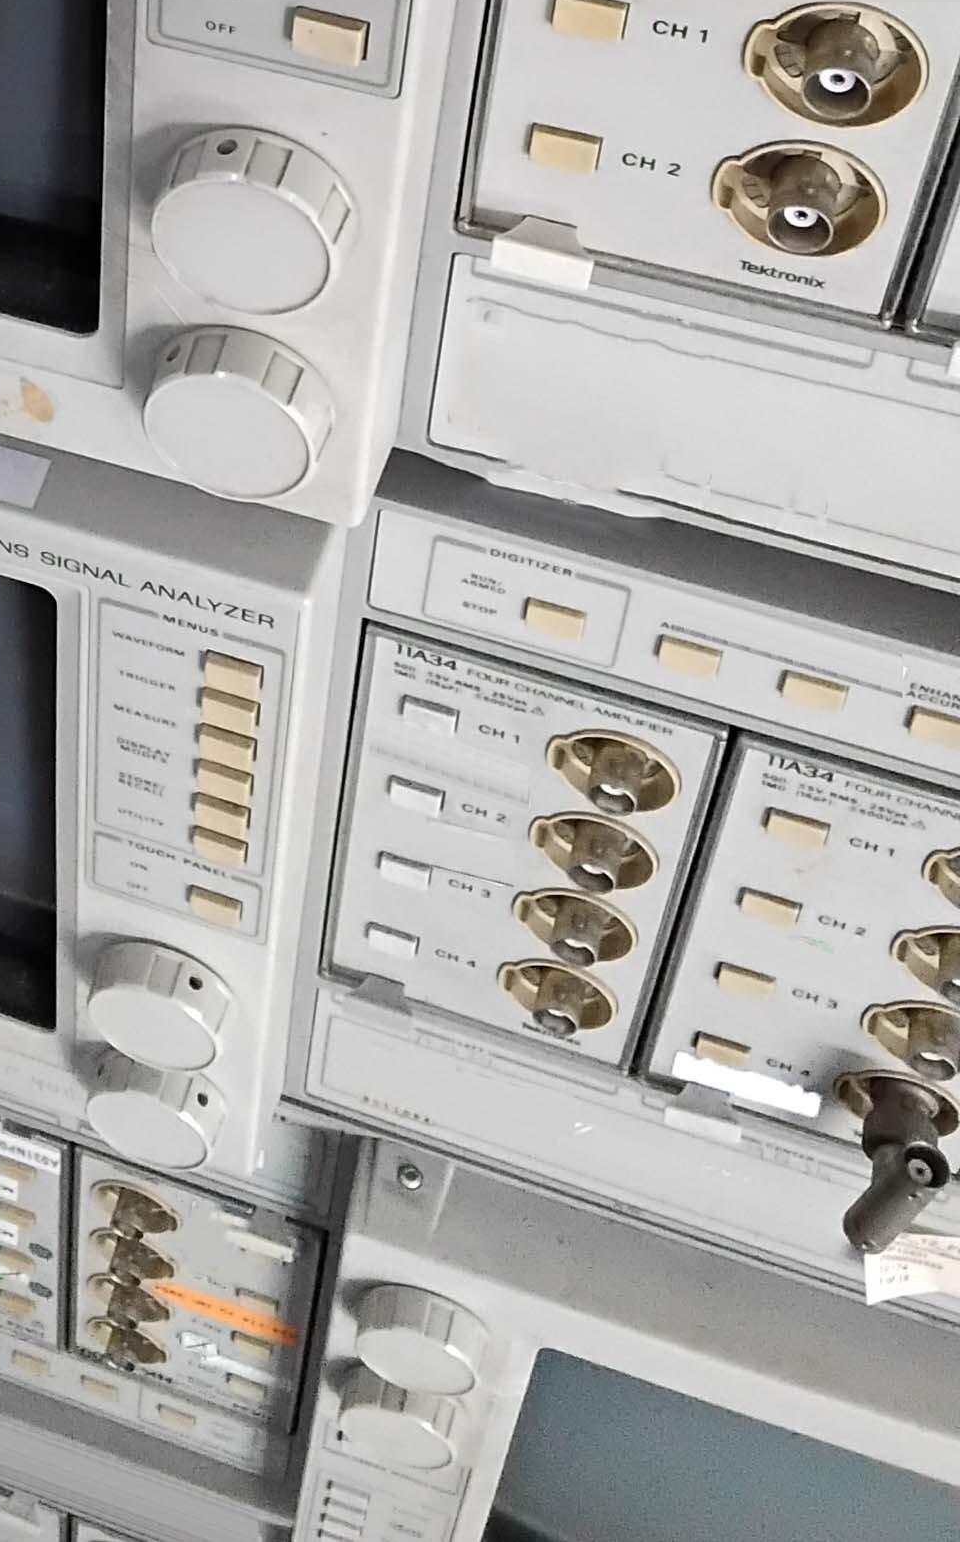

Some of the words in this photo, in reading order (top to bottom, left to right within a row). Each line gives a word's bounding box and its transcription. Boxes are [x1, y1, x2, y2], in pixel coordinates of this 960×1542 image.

[205, 20, 238, 35] OFF
[652, 19, 688, 41] CH
[698, 28, 710, 44] 1
[621, 151, 656, 172] CH
[667, 161, 682, 177] 2
[738, 259, 827, 290] Tektronix
[490, 547, 573, 577] DIGITIZER
[40, 550, 130, 588] SIGNAL
[140, 580, 276, 630] ANALYZER
[462, 601, 497, 615] STOP
[162, 614, 219, 637] MENUS
[111, 629, 185, 657] WAVEFORM
[395, 642, 457, 671] 11A34
[466, 667, 510, 689] FOUR
[514, 682, 587, 710] CHANNEL
[594, 706, 674, 737] AMPLIFIER
[479, 723, 506, 740] CH
[512, 734, 521, 744] 1
[767, 754, 834, 783] 11A34
[844, 779, 892, 802] FOUR
[461, 801, 490, 817] CH
[496, 811, 508, 824] 2
[849, 837, 878, 853] CH
[888, 847, 896, 858] 1
[448, 877, 477, 892] CH
[481, 889, 492, 899] 3
[818, 915, 848, 931] CH
[853, 924, 867, 937] 2
[434, 947, 462, 962] CH
[465, 957, 477, 968] 4
[792, 987, 822, 1004] CH
[826, 998, 839, 1010] 3
[766, 1058, 793, 1073] CH
[798, 1066, 812, 1078] 4
